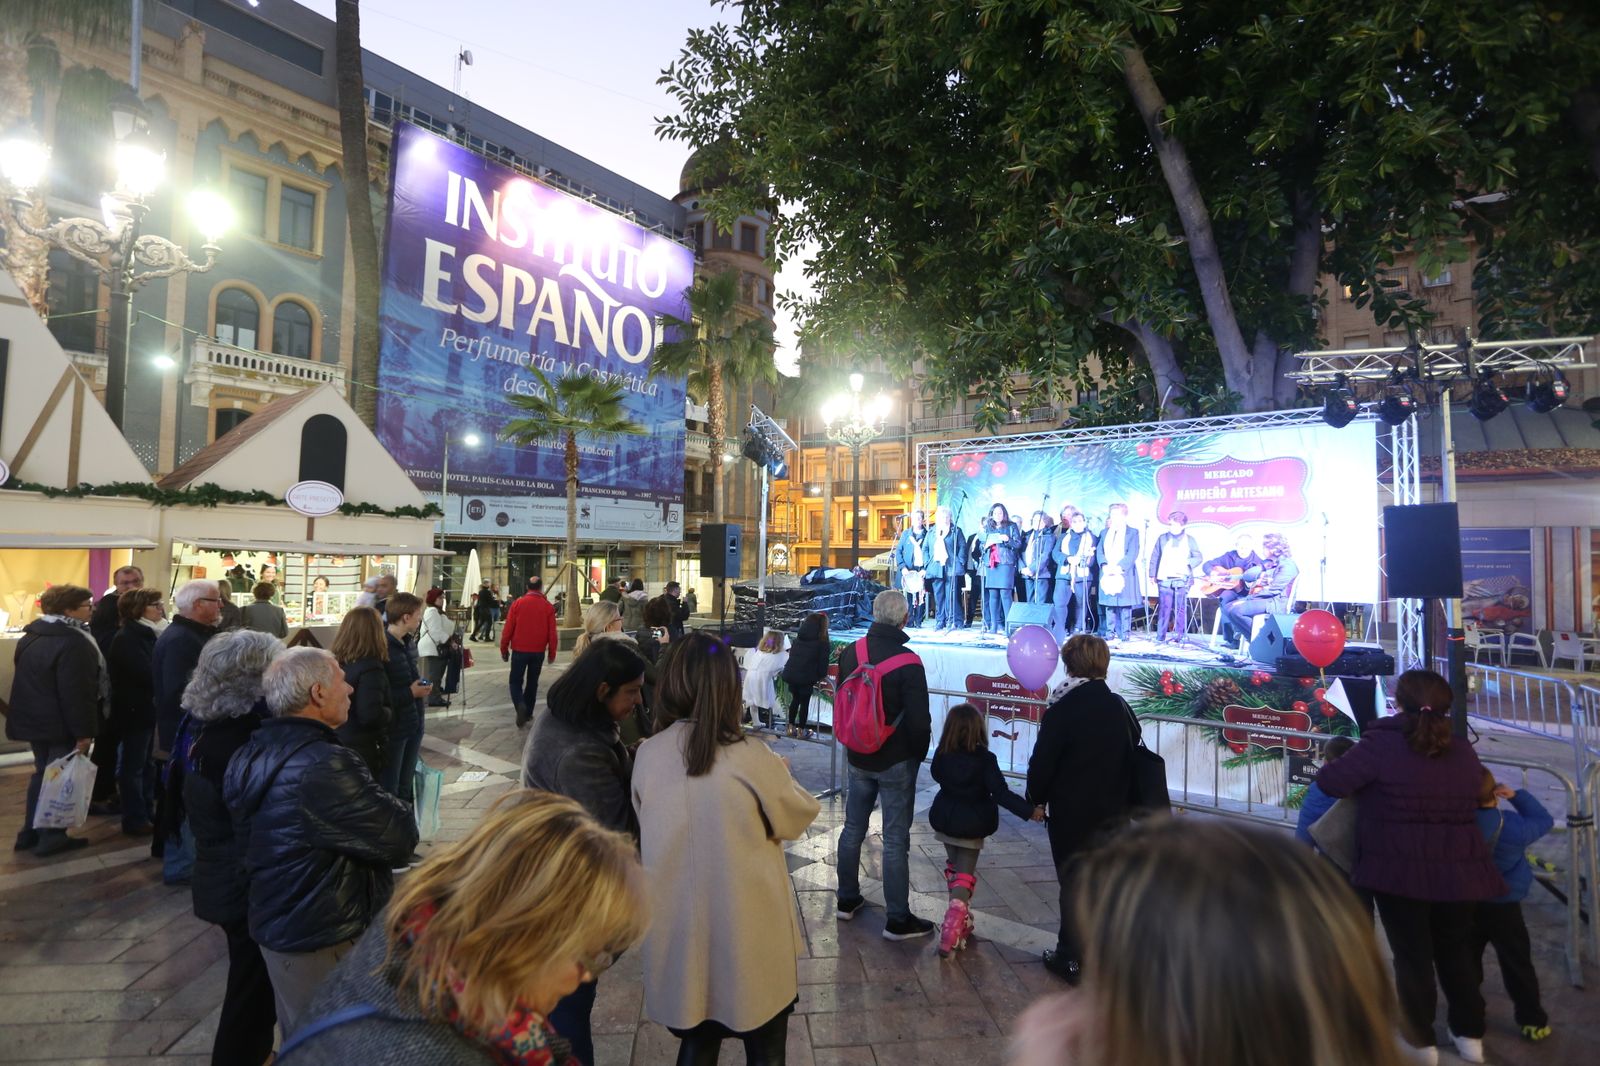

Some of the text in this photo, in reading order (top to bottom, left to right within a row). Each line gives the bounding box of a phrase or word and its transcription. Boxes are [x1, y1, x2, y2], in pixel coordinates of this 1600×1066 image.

[440, 328, 555, 372] Perfumería
[561, 359, 576, 378] y
[1204, 469, 1254, 480] MERCADO
[526, 480, 536, 488] LA
[536, 481, 555, 490] BOLA
[1176, 485, 1285, 501] NAVIDEÑO ARTESANO
[991, 681, 1020, 690] MERCADO
[1252, 713, 1281, 721] MERCADO
